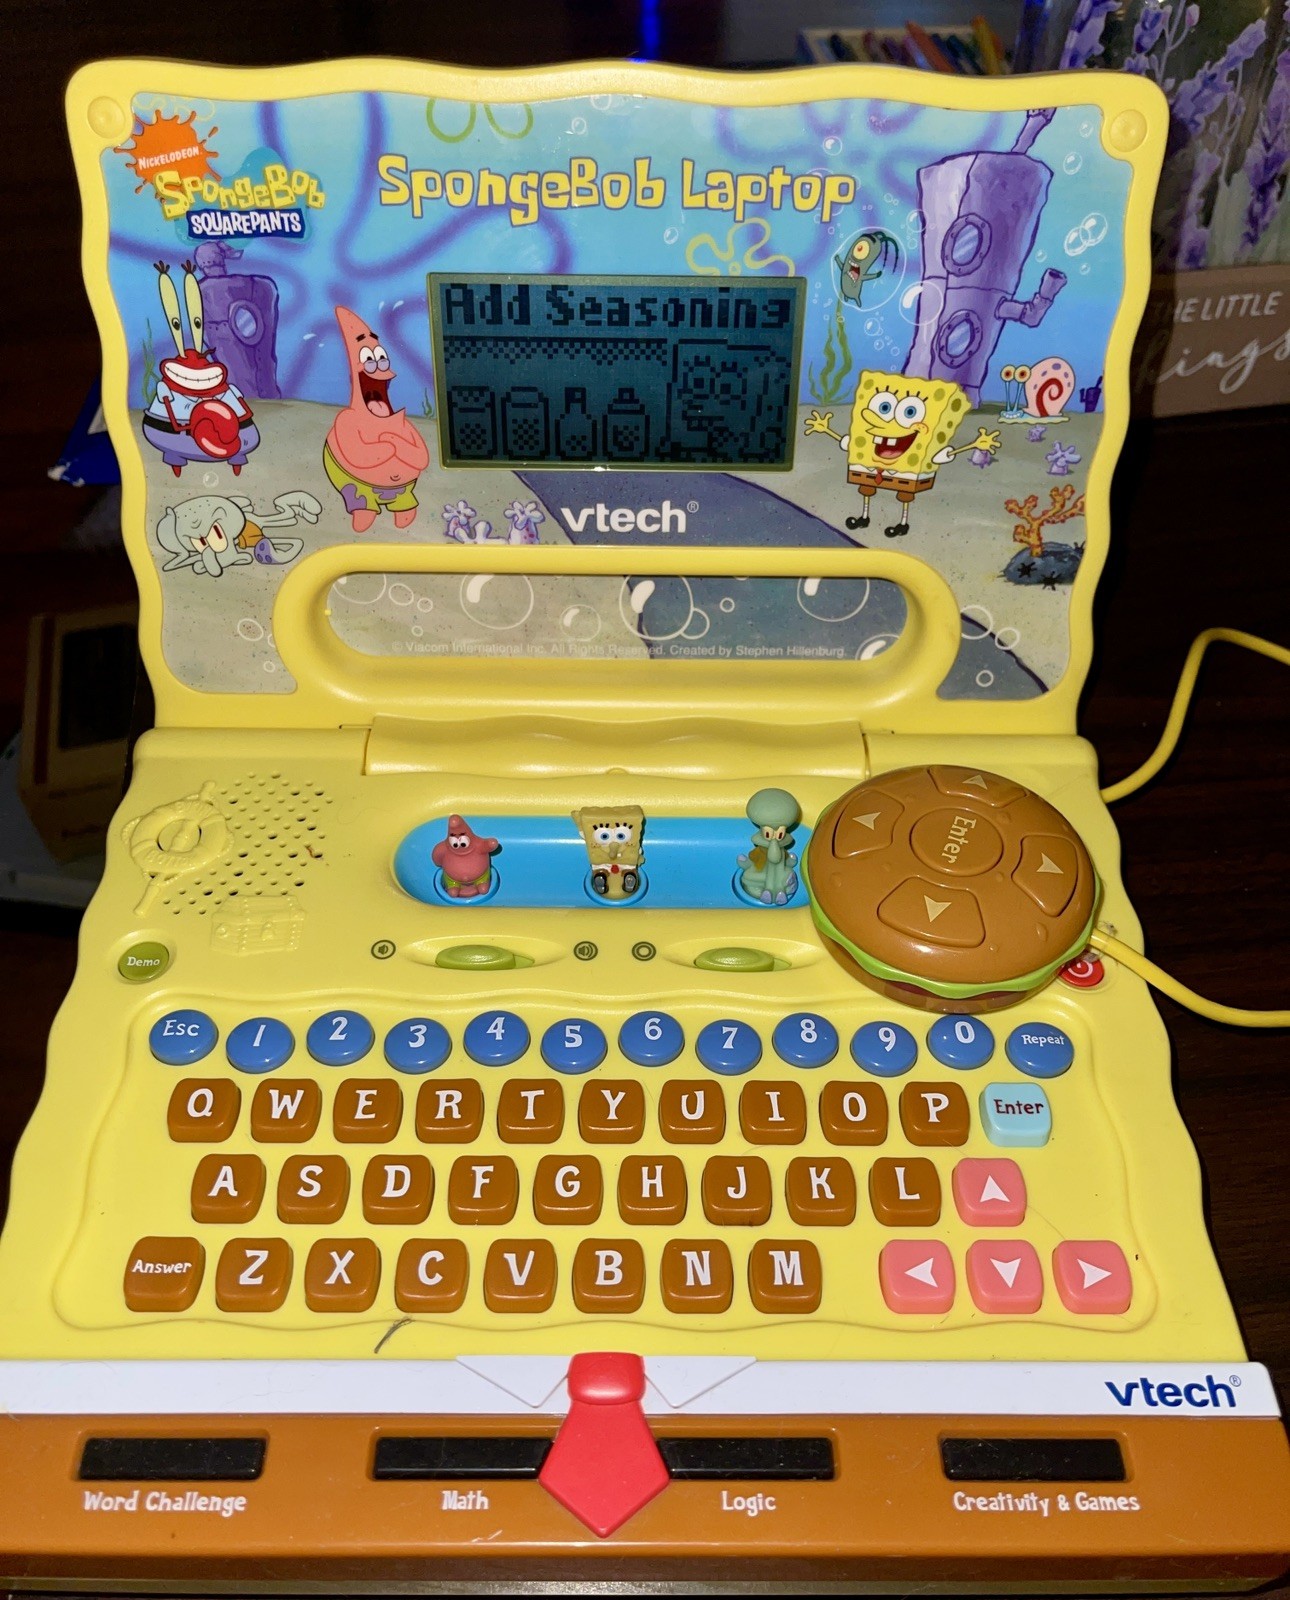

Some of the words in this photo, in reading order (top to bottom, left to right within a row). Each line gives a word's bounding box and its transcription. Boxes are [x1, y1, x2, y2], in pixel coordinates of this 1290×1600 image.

[138, 146, 200, 170] NICKELODEON
[378, 154, 666, 226] SpongeBob
[682, 158, 856, 223] Laptop
[190, 210, 302, 236] SQUAREPANTS
[445, 283, 530, 326] Add
[546, 285, 791, 329] Seasoning
[1201, 290, 1283, 322] LITTLE
[405, 641, 449, 653] Viacom
[451, 640, 523, 654] International
[526, 642, 547, 654] Inc.
[550, 643, 565, 655] All
[568, 643, 605, 657] Rights
[608, 644, 667, 656] Reserved.
[669, 644, 716, 656] Created
[718, 644, 733, 658] by
[735, 645, 784, 658] Stephen
[942, 815, 977, 864] Enter
[126, 956, 161, 967] Demo
[162, 1019, 200, 1038] Esc
[252, 1024, 267, 1047] 1
[328, 1016, 348, 1041] 2
[408, 1024, 427, 1048] 3
[486, 1016, 505, 1041] 4
[564, 1025, 583, 1048] 5
[644, 1017, 663, 1041] 6
[722, 1026, 738, 1049] 7
[800, 1018, 818, 1044] 8
[878, 1026, 897, 1052] 9
[954, 1021, 975, 1044] 0
[1021, 1033, 1065, 1047] Repeat
[187, 1088, 214, 1118] Q
[269, 1089, 305, 1120] W
[354, 1089, 377, 1120] E
[435, 1089, 463, 1119] R
[520, 1089, 545, 1120] T
[601, 1089, 626, 1120] Y
[681, 1090, 705, 1120] U
[765, 1091, 785, 1121] I
[843, 1092, 867, 1122] O
[920, 1092, 949, 1123] P
[994, 1099, 1044, 1115] Enter
[208, 1165, 238, 1197] A
[297, 1165, 323, 1198] S
[381, 1164, 411, 1198] D
[471, 1165, 494, 1199] F
[554, 1165, 581, 1198] G
[641, 1165, 664, 1198] H
[727, 1166, 747, 1199] J
[809, 1167, 835, 1199] K
[894, 1167, 921, 1200] L
[131, 1259, 192, 1274] Answer
[238, 1249, 269, 1285] Z
[324, 1249, 355, 1285] X
[417, 1250, 445, 1286] C
[503, 1250, 535, 1286] V
[595, 1250, 623, 1286] B
[681, 1250, 712, 1286] N
[768, 1250, 804, 1286] M
[83, 1490, 138, 1512] Word
[145, 1491, 247, 1518] Challenge
[441, 1490, 489, 1511] Math
[721, 1490, 777, 1517] Logic
[953, 1491, 1050, 1517] Creativity
[1057, 1494, 1071, 1512] &
[1074, 1491, 1141, 1512] Games
